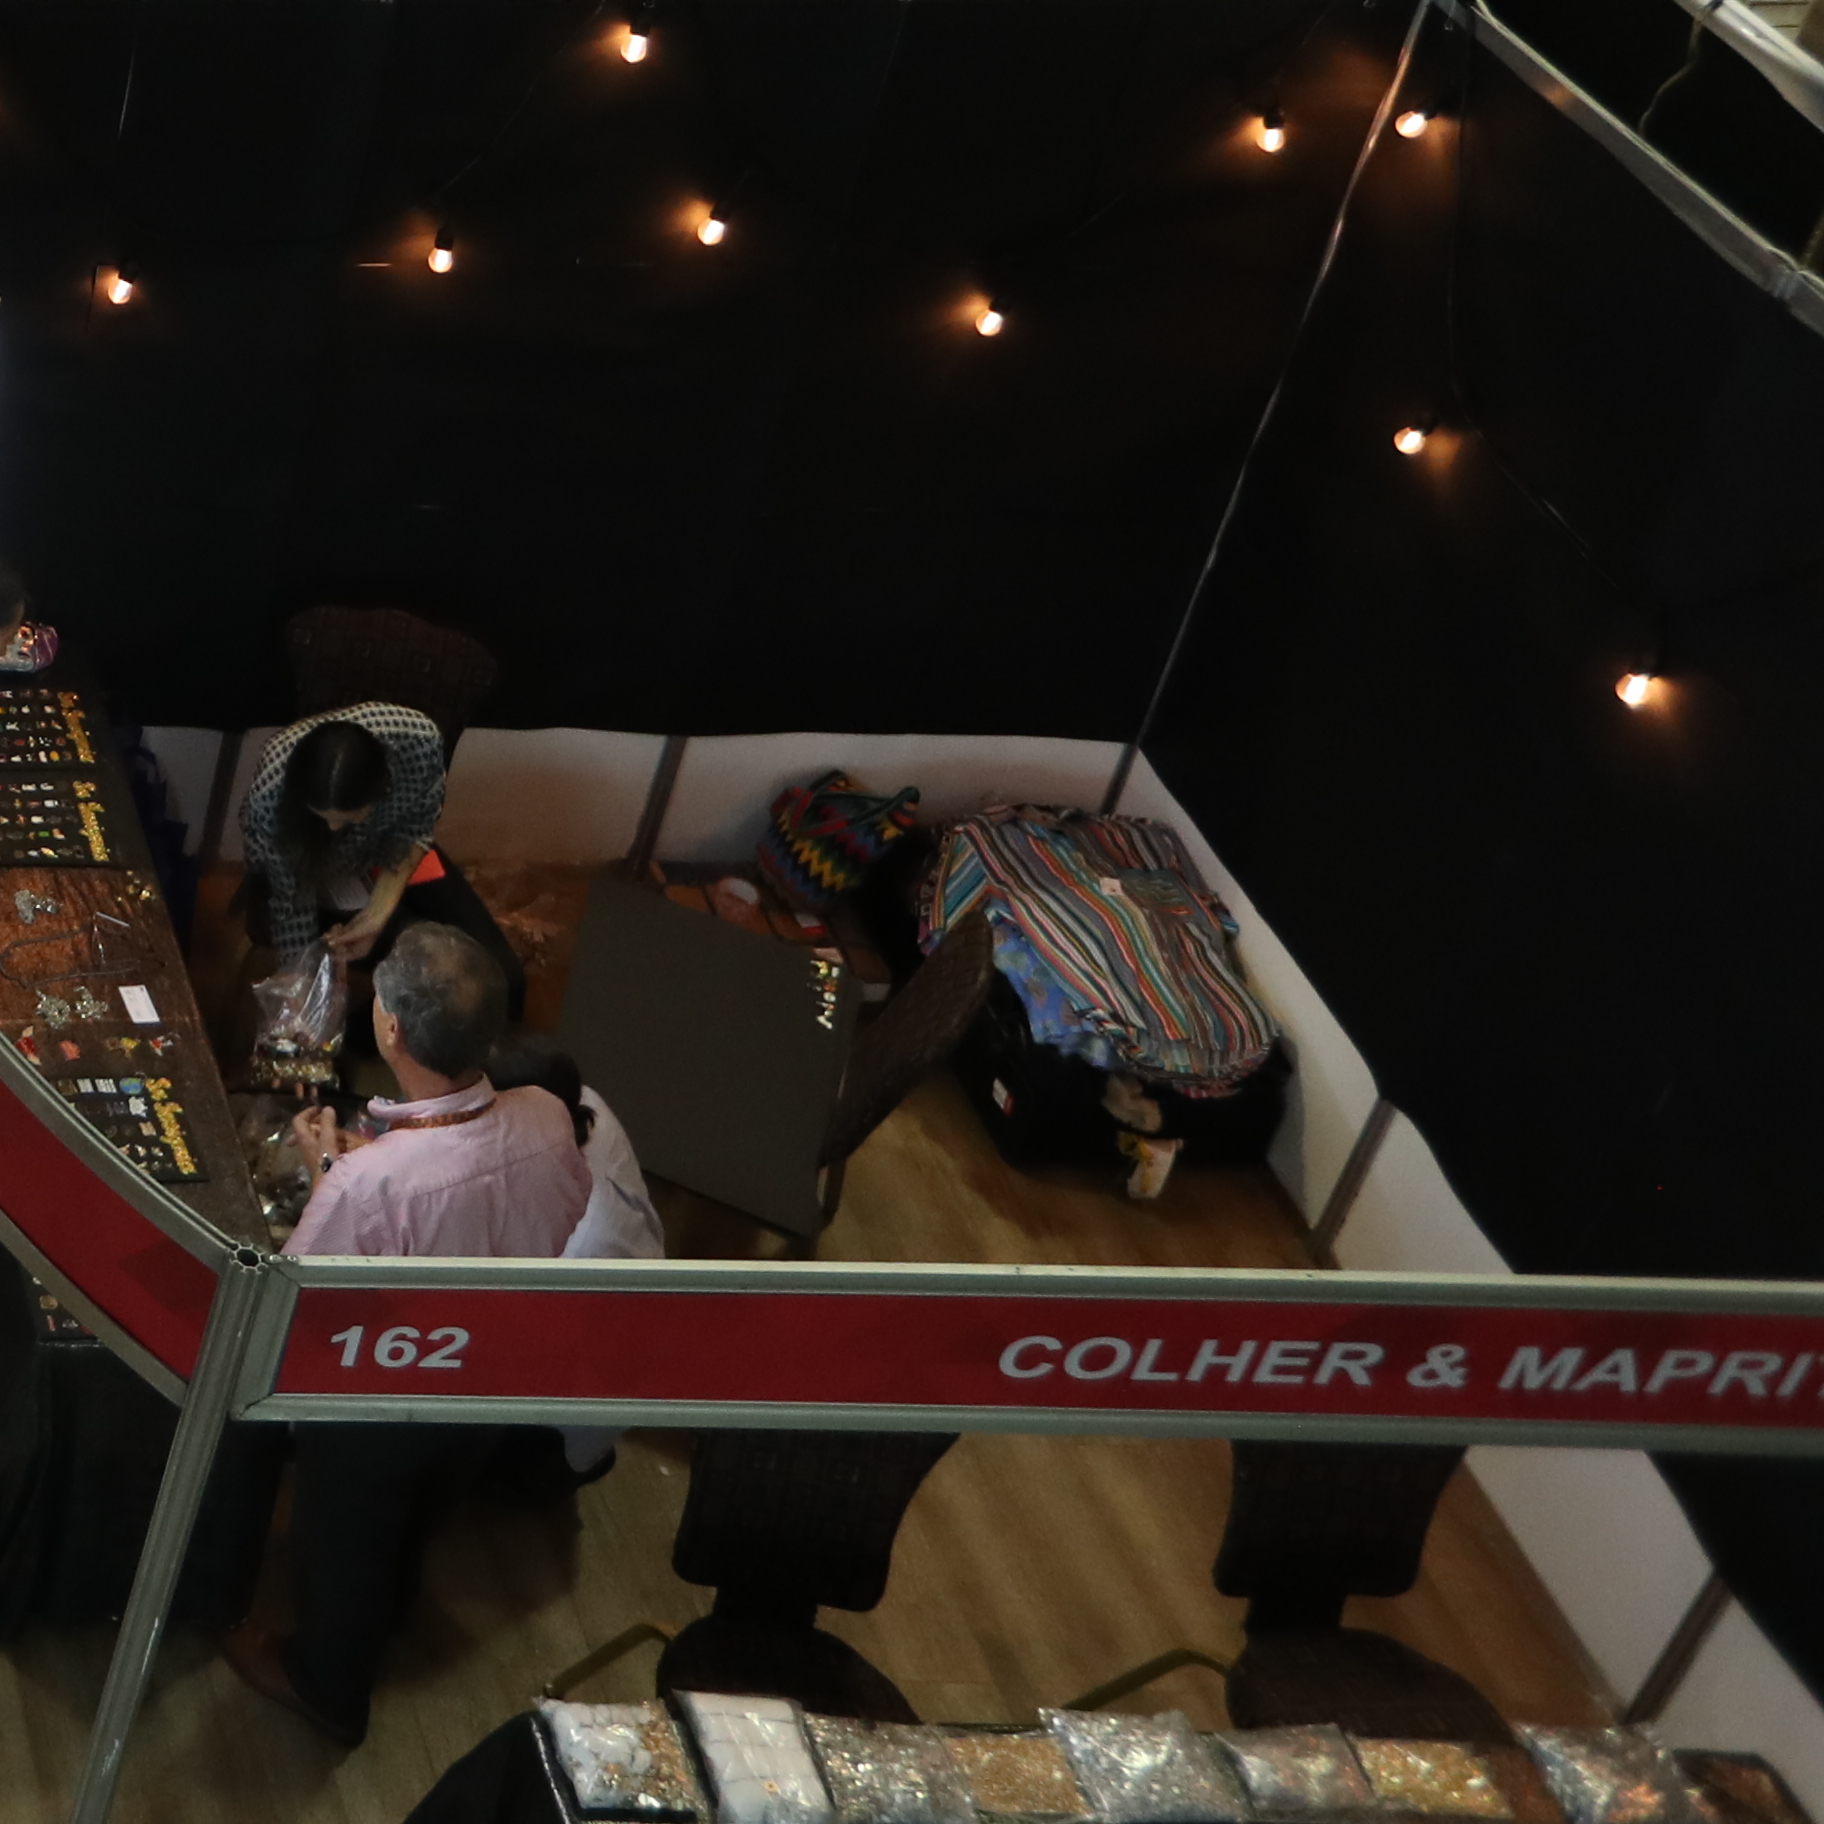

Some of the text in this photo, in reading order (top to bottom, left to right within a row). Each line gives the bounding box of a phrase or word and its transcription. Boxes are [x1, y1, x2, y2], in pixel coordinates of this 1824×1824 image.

[325, 1324, 1824, 1401] 162 COLHER & MAPRI
